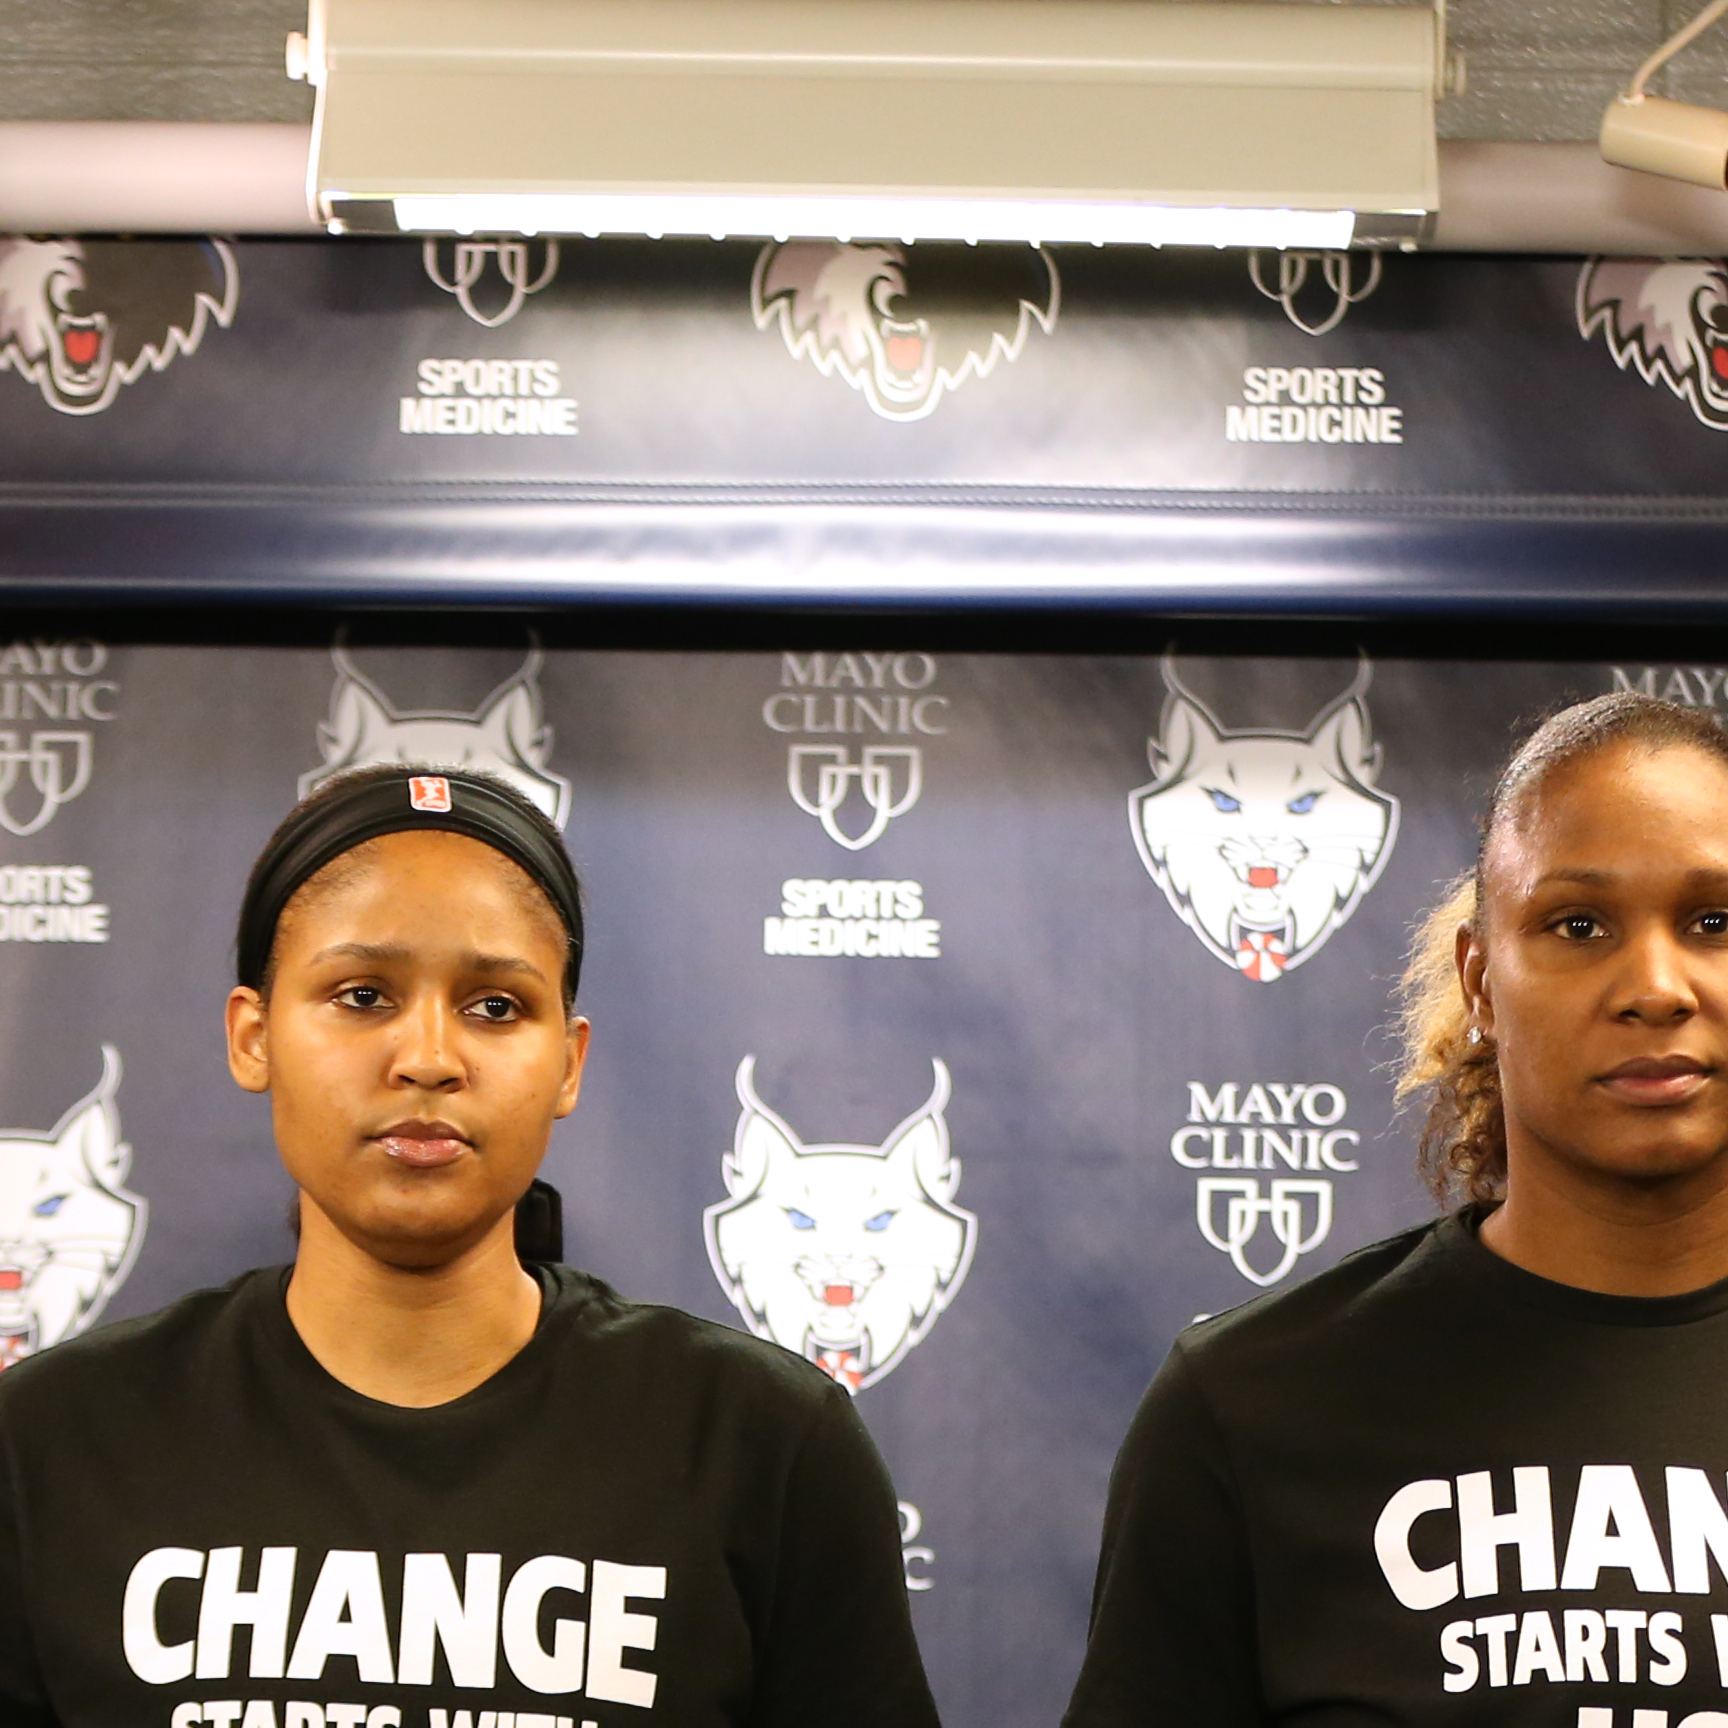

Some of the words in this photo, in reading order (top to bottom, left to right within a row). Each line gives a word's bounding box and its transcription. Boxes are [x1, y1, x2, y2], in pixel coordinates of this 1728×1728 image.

[417, 358, 562, 398] SPORTS
[1243, 366, 1386, 406] SPORTS
[399, 397, 579, 436] MEDICINE
[1225, 405, 1403, 444] MEDICINE
[780, 651, 937, 689] MAYO
[762, 692, 951, 735] CLINIC
[781, 878, 924, 919] SPORTS
[763, 916, 941, 958] MEDICINE
[1187, 1081, 1347, 1127] MAYO
[1170, 1127, 1360, 1173] CLINIC
[123, 1546, 667, 1708] CHANGE
[1440, 1609, 1688, 1693] STARTS
